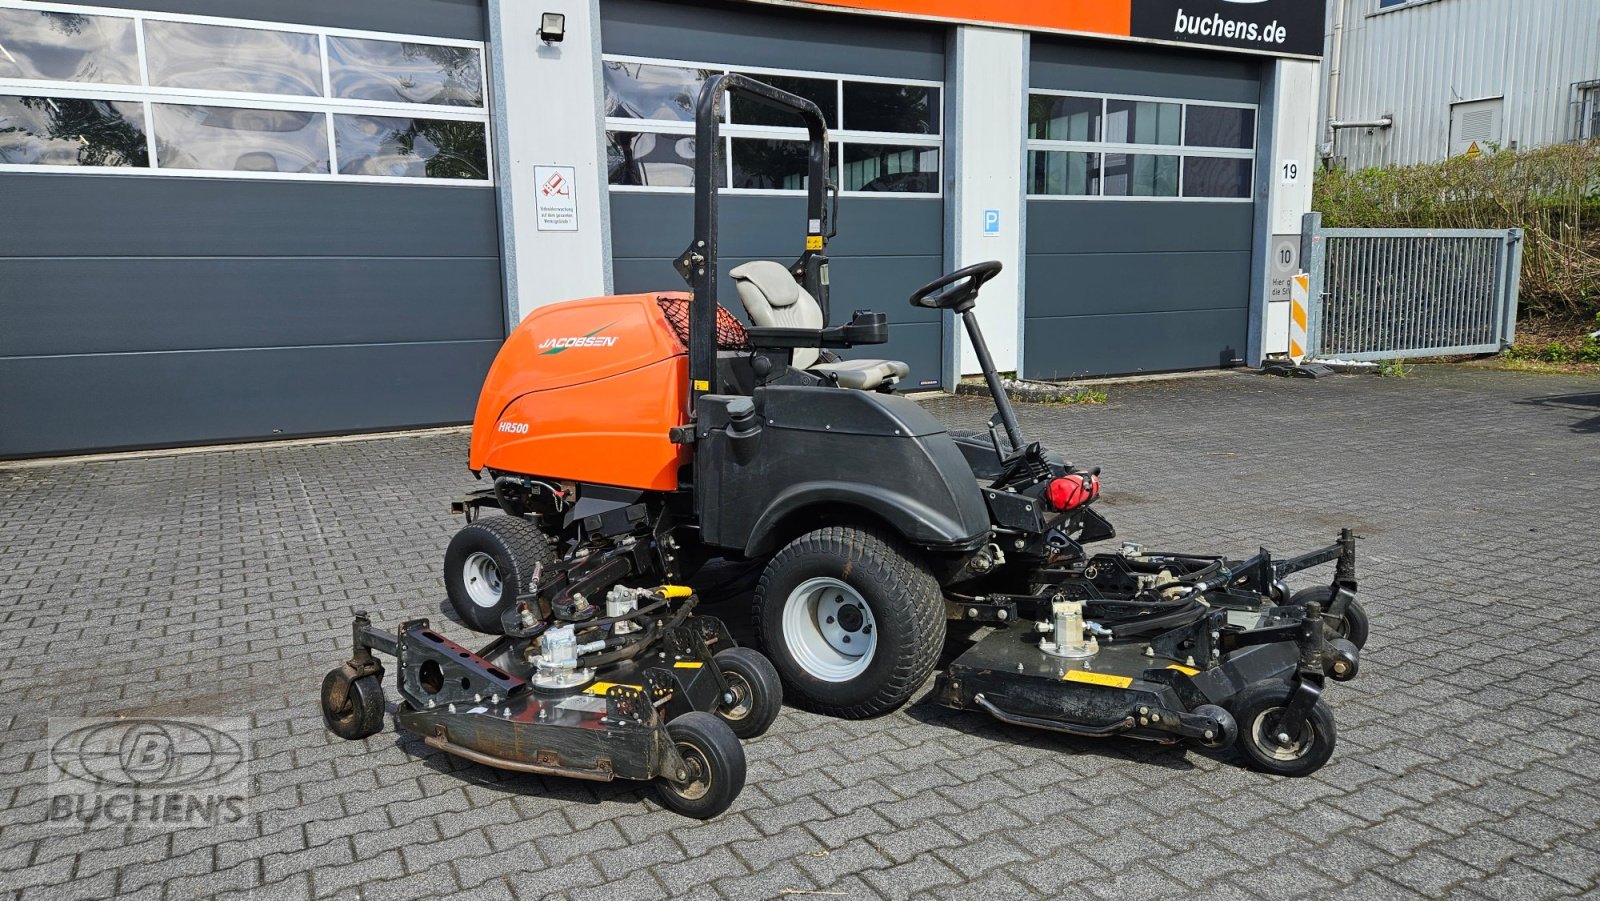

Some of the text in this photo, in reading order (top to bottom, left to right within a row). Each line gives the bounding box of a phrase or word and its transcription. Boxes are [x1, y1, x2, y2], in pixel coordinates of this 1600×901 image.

[1174, 8, 1287, 44] buchens.de
[1283, 163, 1297, 180] 19
[986, 211, 998, 231] P
[1280, 249, 1291, 264] 10
[539, 336, 616, 348] JACOBSEN
[498, 422, 529, 434] HR500
